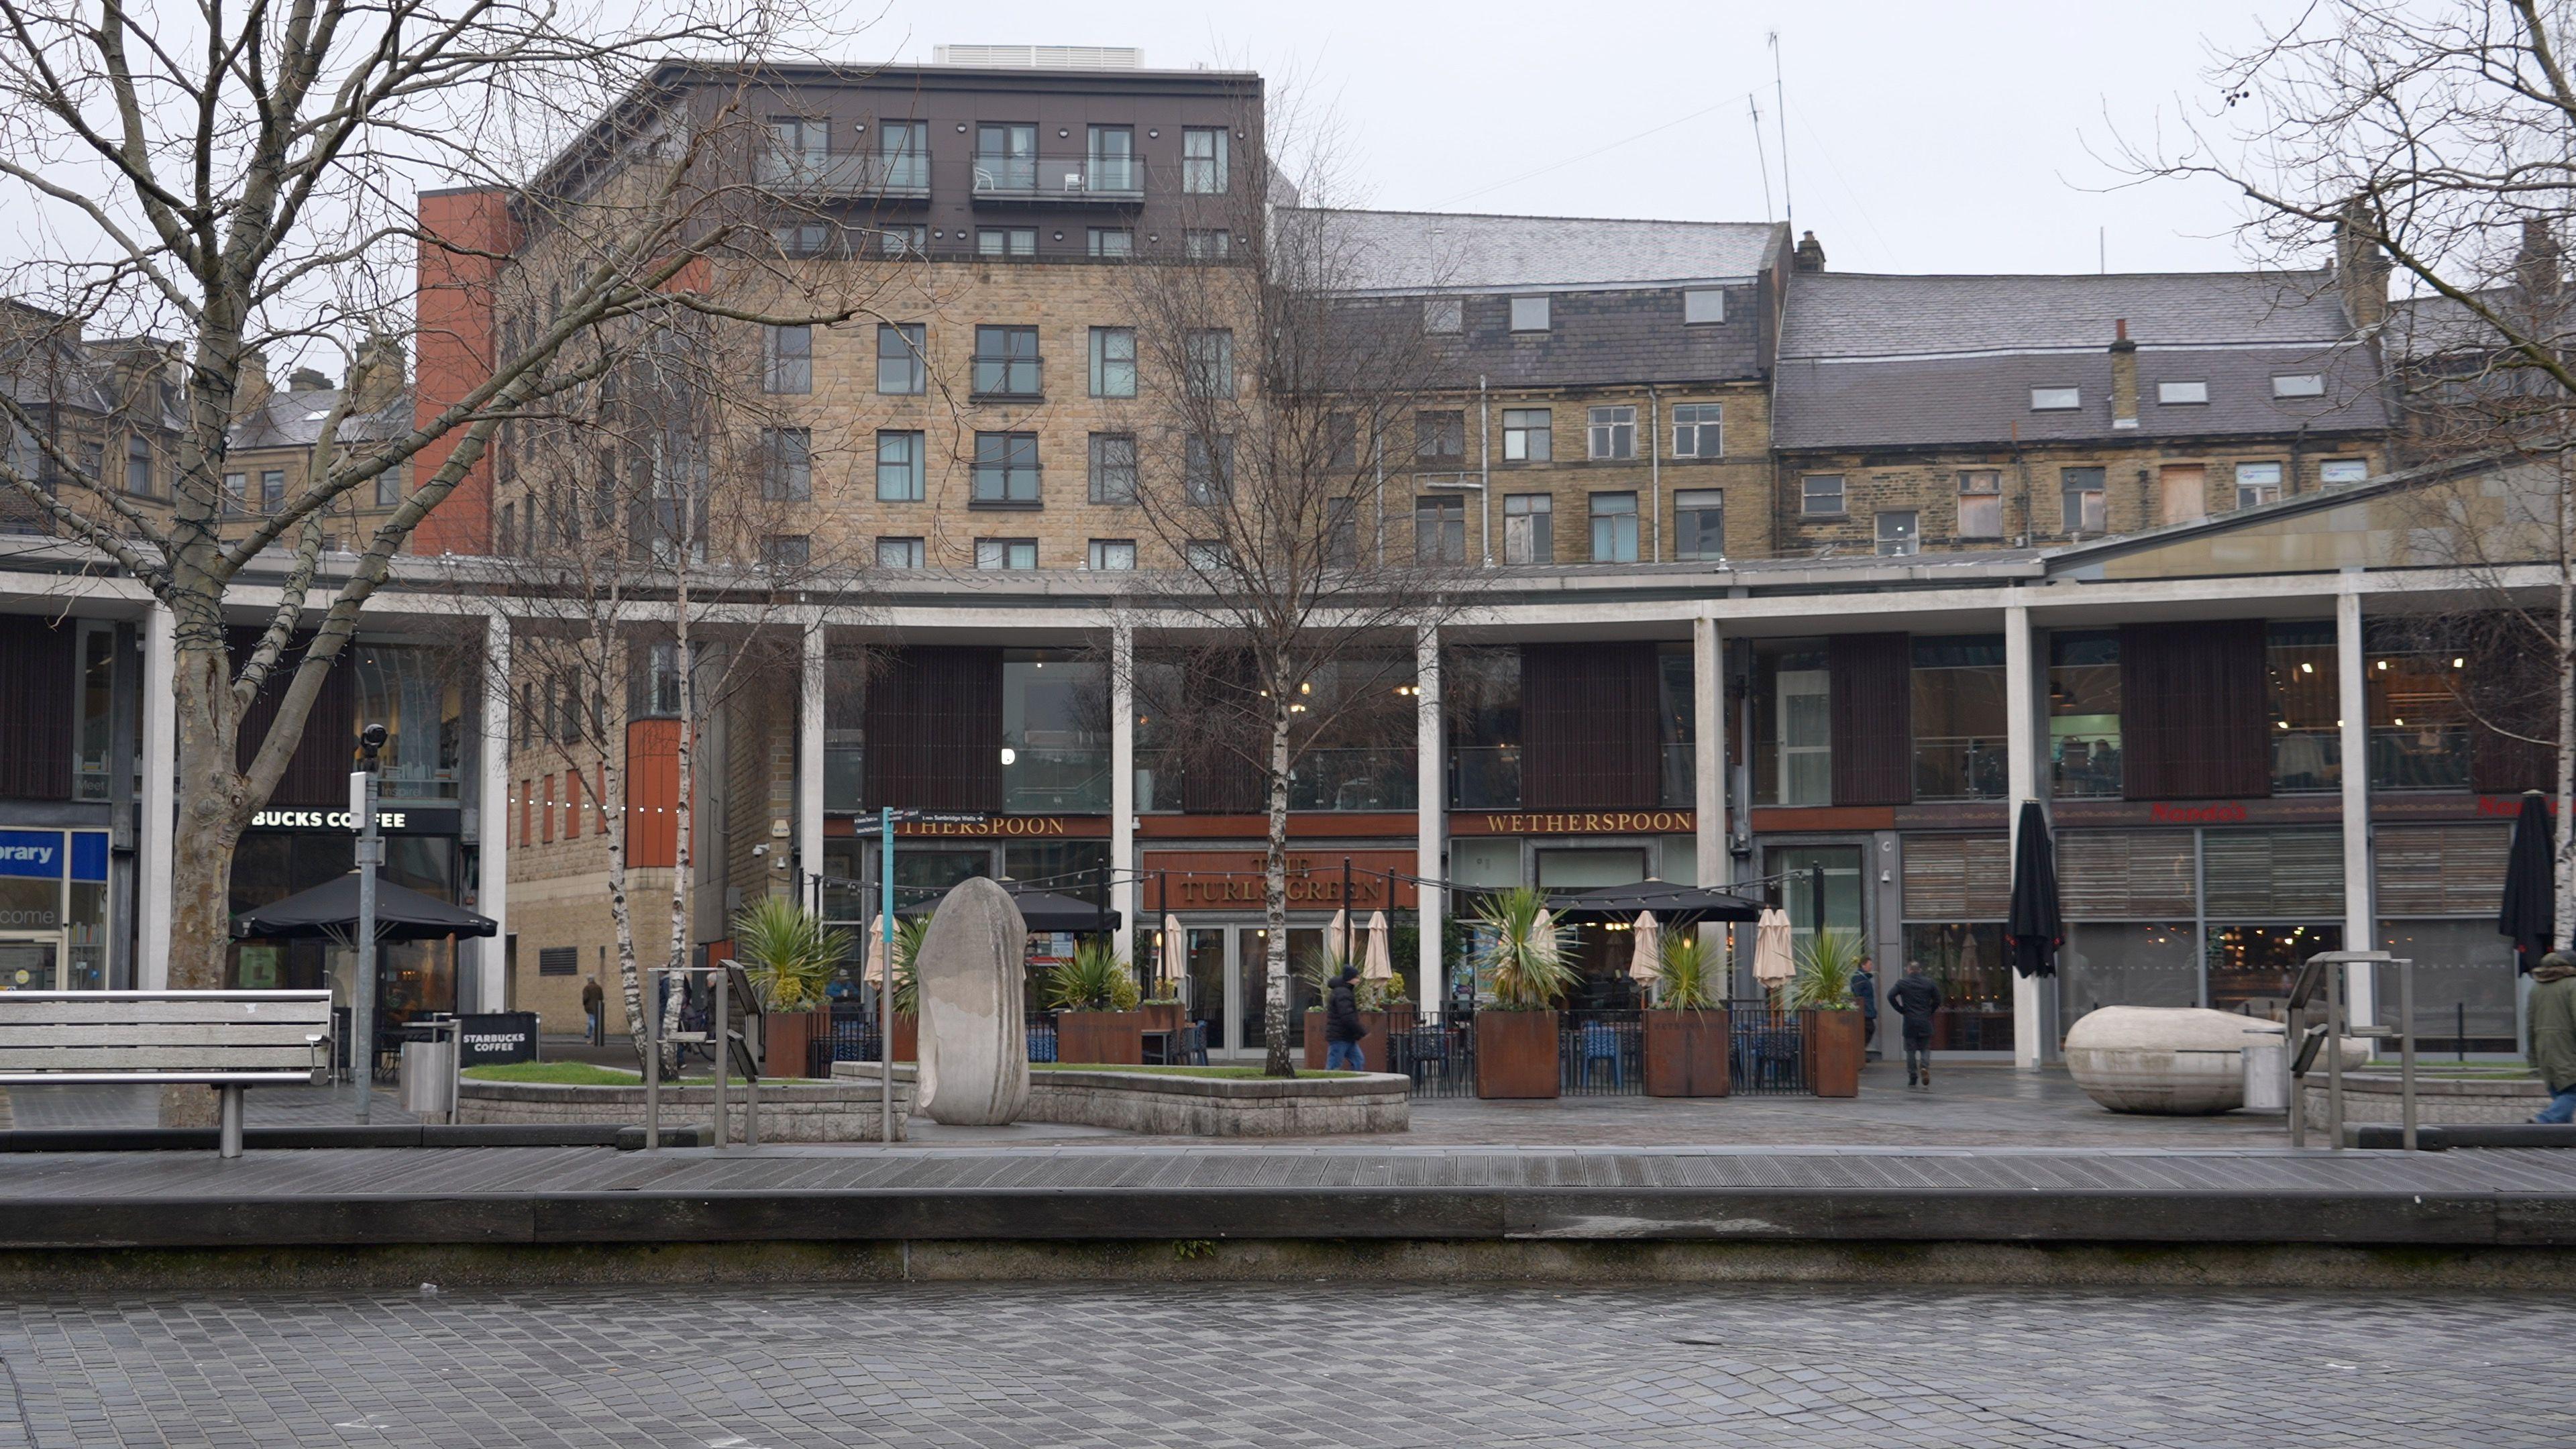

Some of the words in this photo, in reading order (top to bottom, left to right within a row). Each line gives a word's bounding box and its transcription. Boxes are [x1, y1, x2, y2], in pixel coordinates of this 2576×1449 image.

[76, 780, 105, 791] Meet
[382, 786, 420, 798] Inspire
[2149, 800, 2247, 822] Nando's
[251, 811, 323, 827] BUCKS
[1486, 812, 1691, 833] WETHERSPOON
[463, 1033, 525, 1043] STARBUCKS
[474, 1042, 515, 1052] COFFEE
